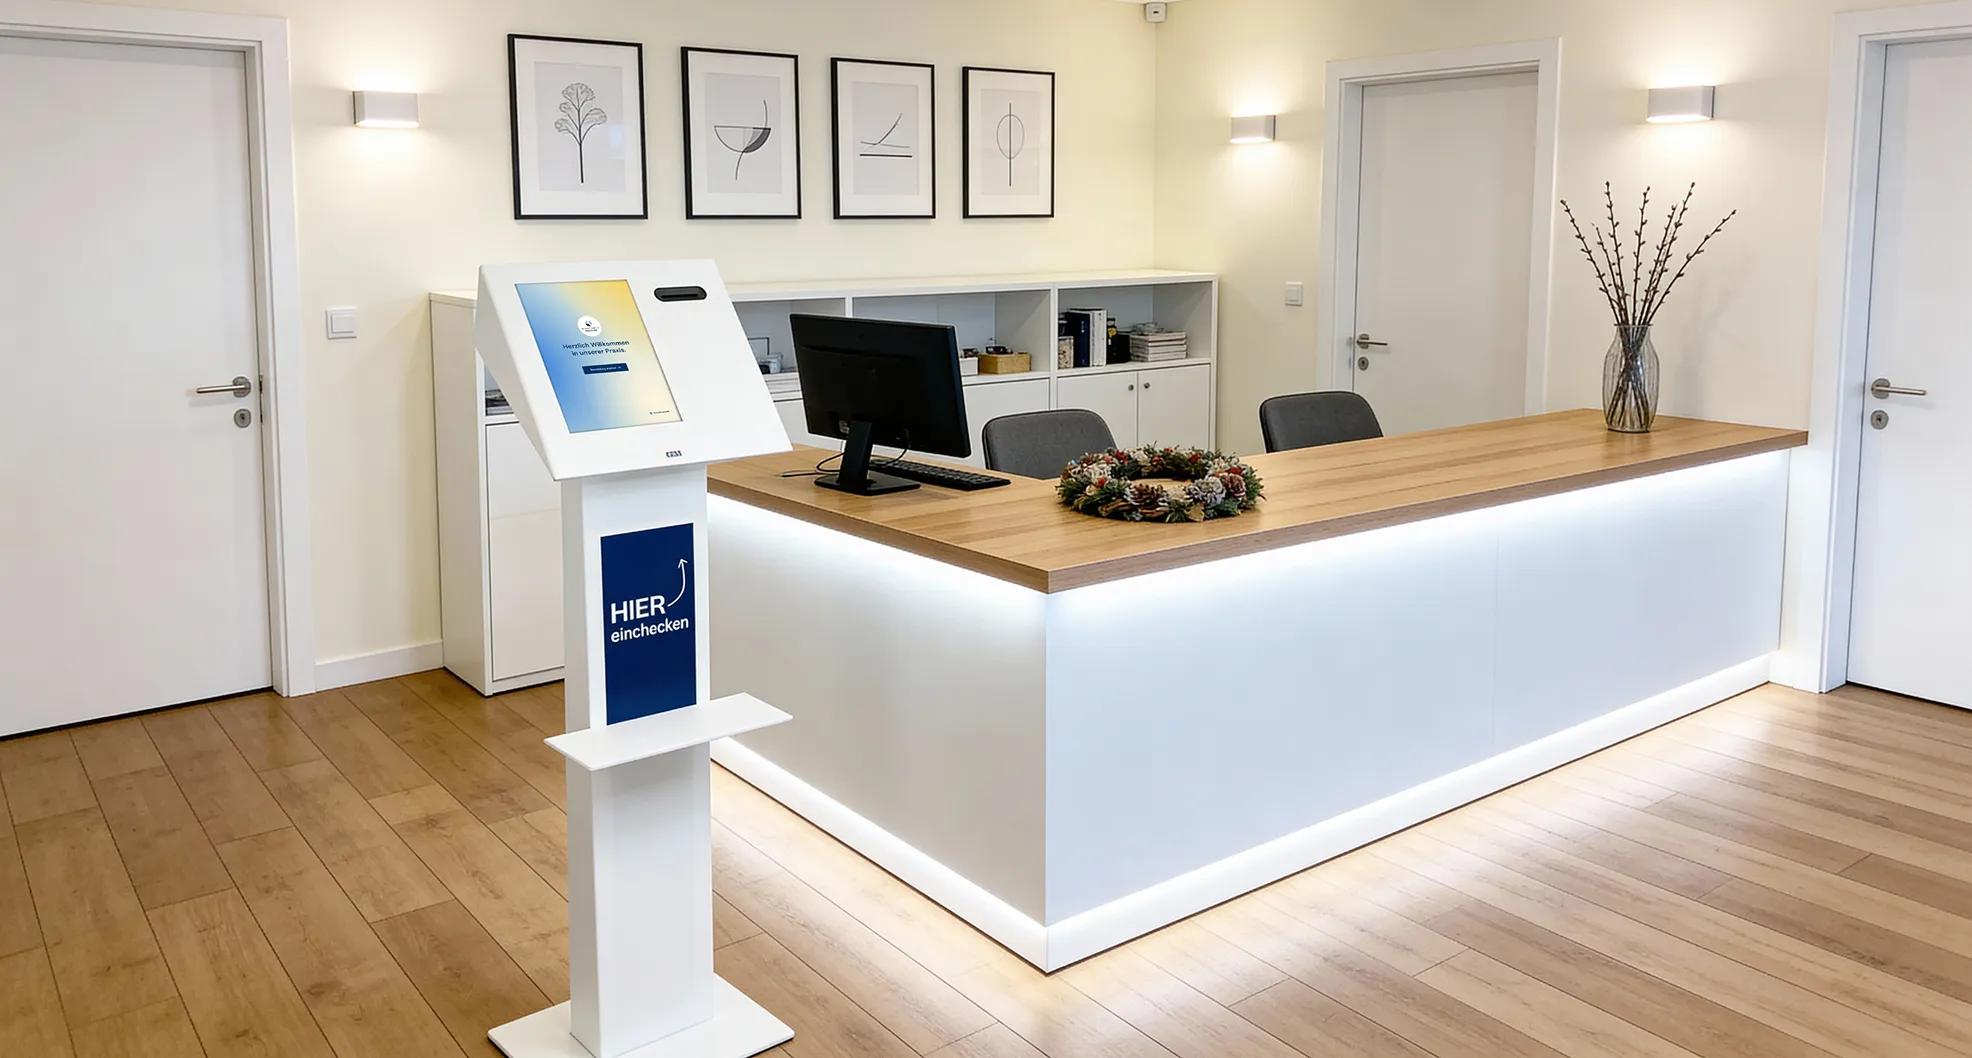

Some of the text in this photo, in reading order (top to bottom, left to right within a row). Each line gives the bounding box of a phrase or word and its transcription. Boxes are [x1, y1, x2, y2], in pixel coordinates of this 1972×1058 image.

[562, 340, 630, 350] Herzlich Willkommen
[611, 595, 666, 624] HIER
[611, 618, 689, 643] einchecken
